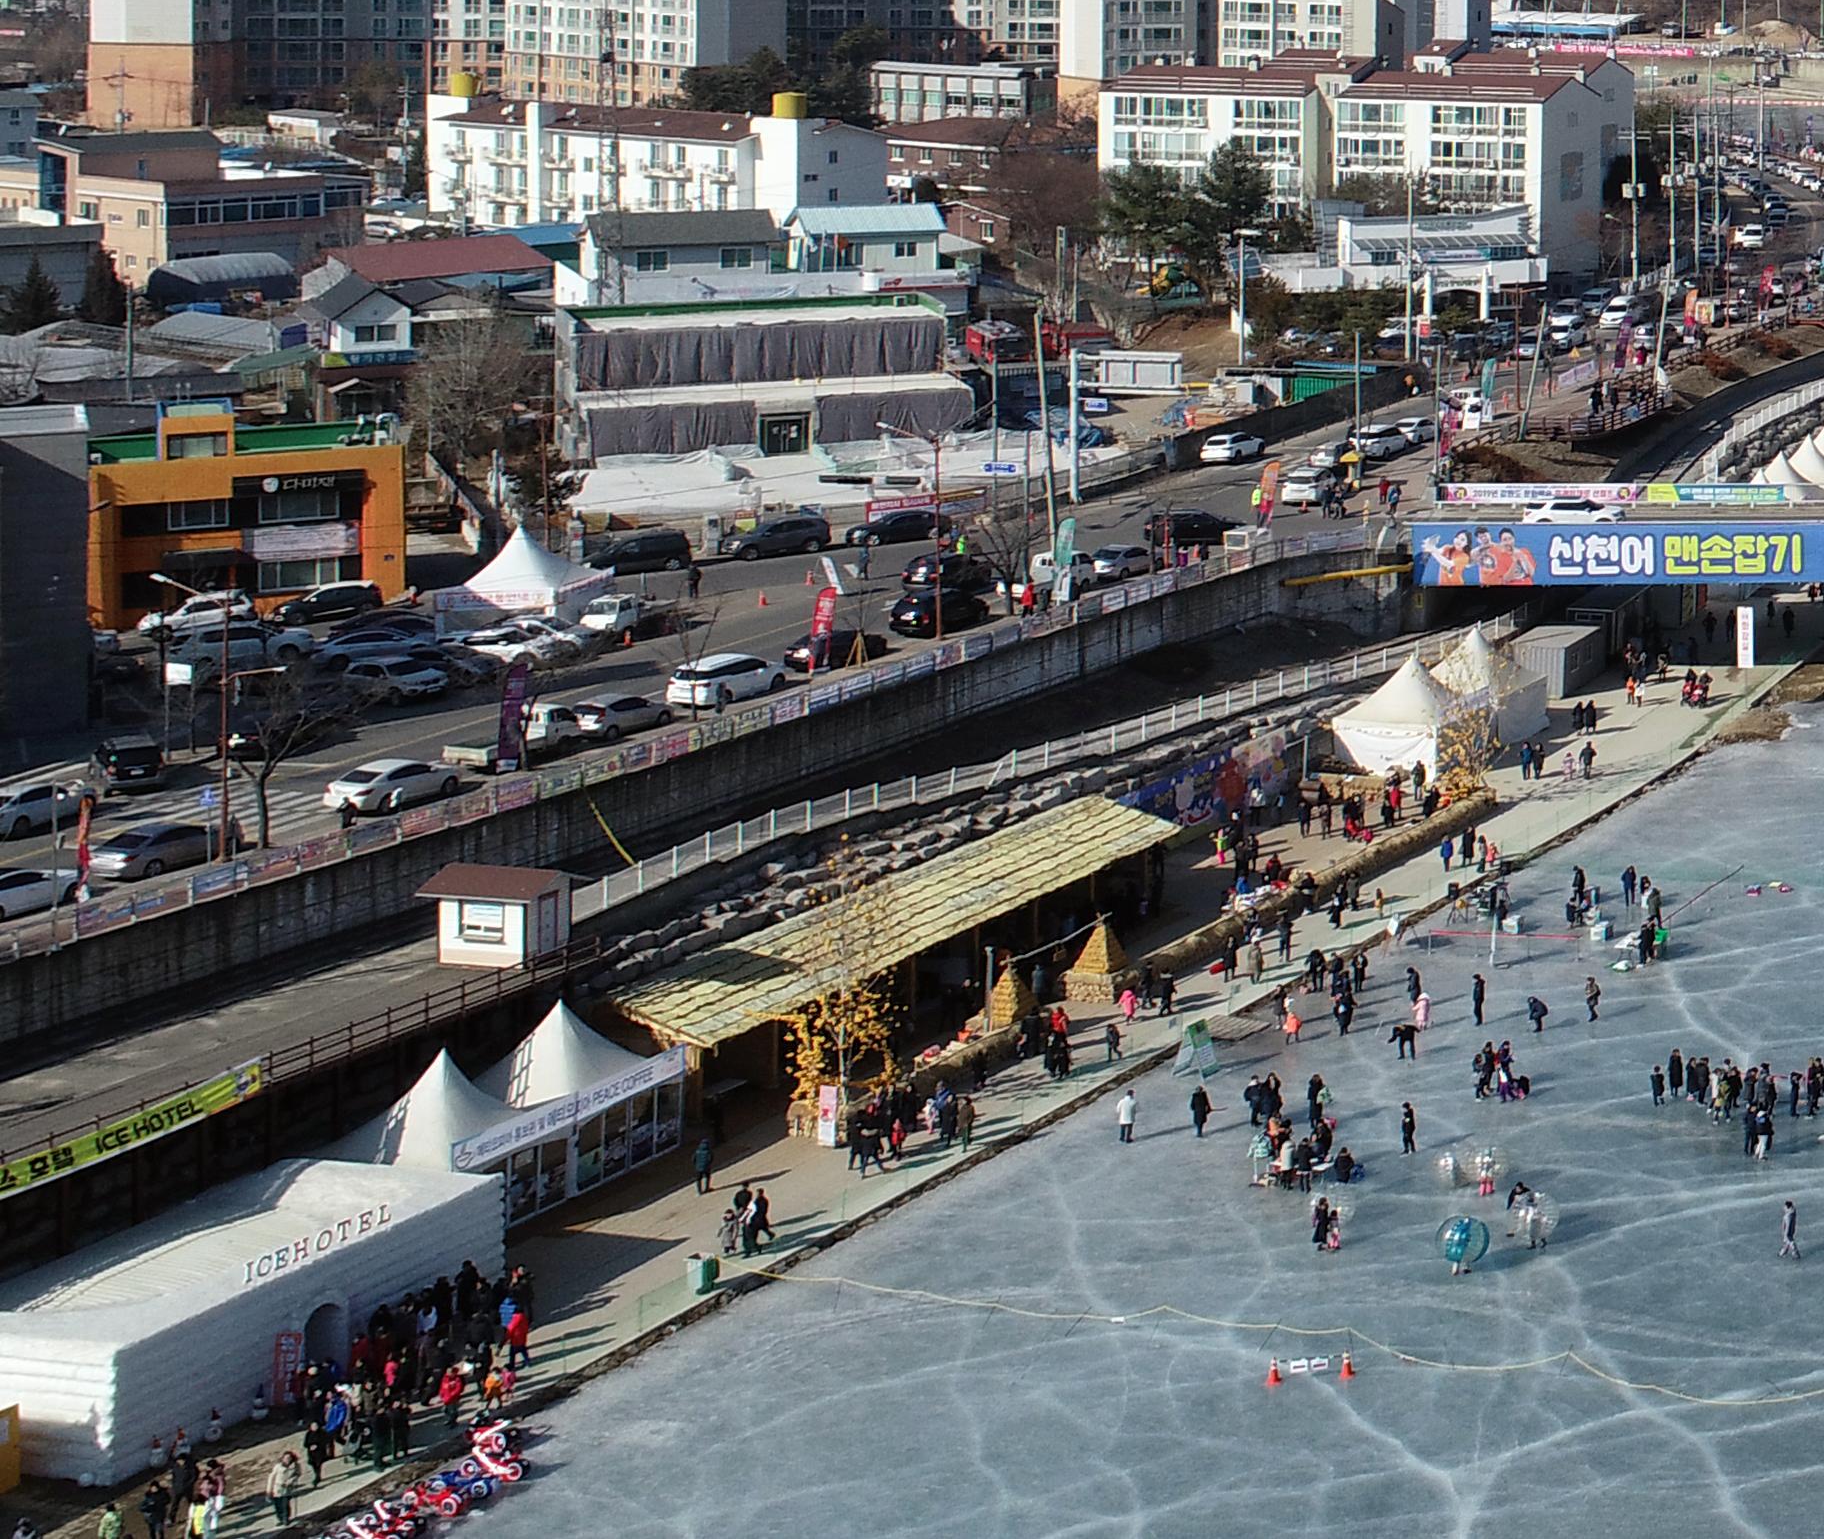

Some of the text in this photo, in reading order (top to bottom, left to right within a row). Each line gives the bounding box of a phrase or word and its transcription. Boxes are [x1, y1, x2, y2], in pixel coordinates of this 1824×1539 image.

[1550, 533, 1802, 576] 산천어 맨손잡기
[591, 1081, 620, 1107] PEACE
[622, 1065, 655, 1093] COFFEE
[95, 1125, 132, 1154] ICE
[133, 1098, 204, 1141] HOTEL
